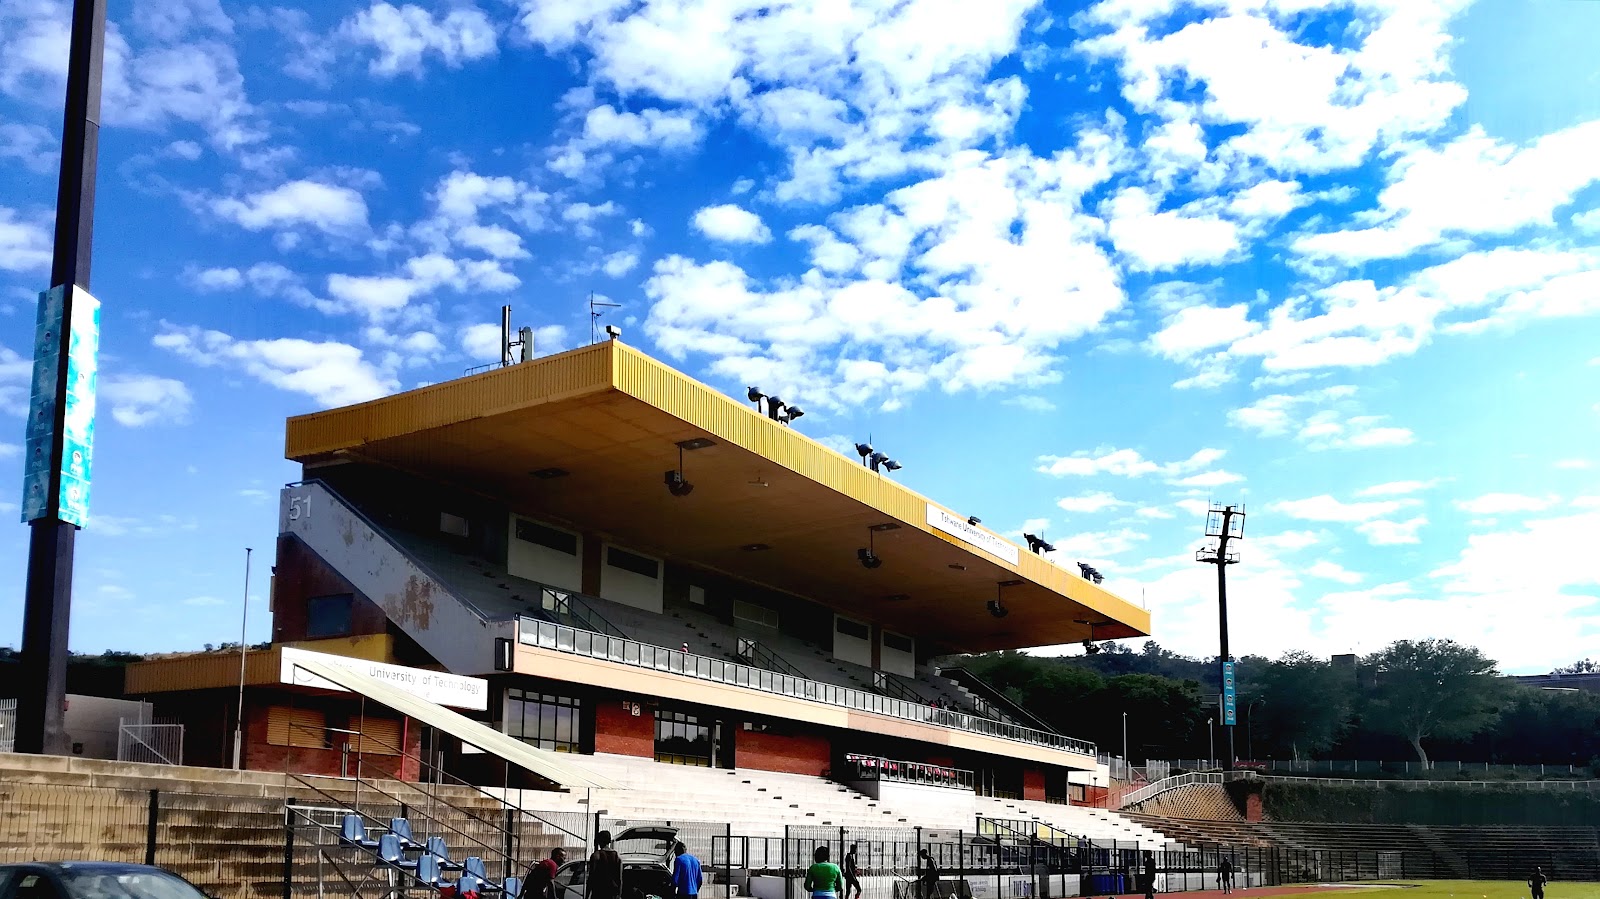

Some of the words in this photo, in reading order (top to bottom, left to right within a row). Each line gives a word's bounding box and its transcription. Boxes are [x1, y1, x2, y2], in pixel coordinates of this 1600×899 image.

[290, 495, 312, 520] 51
[369, 666, 416, 685] University
[422, 674, 432, 686] of
[433, 675, 480, 695] Technology
